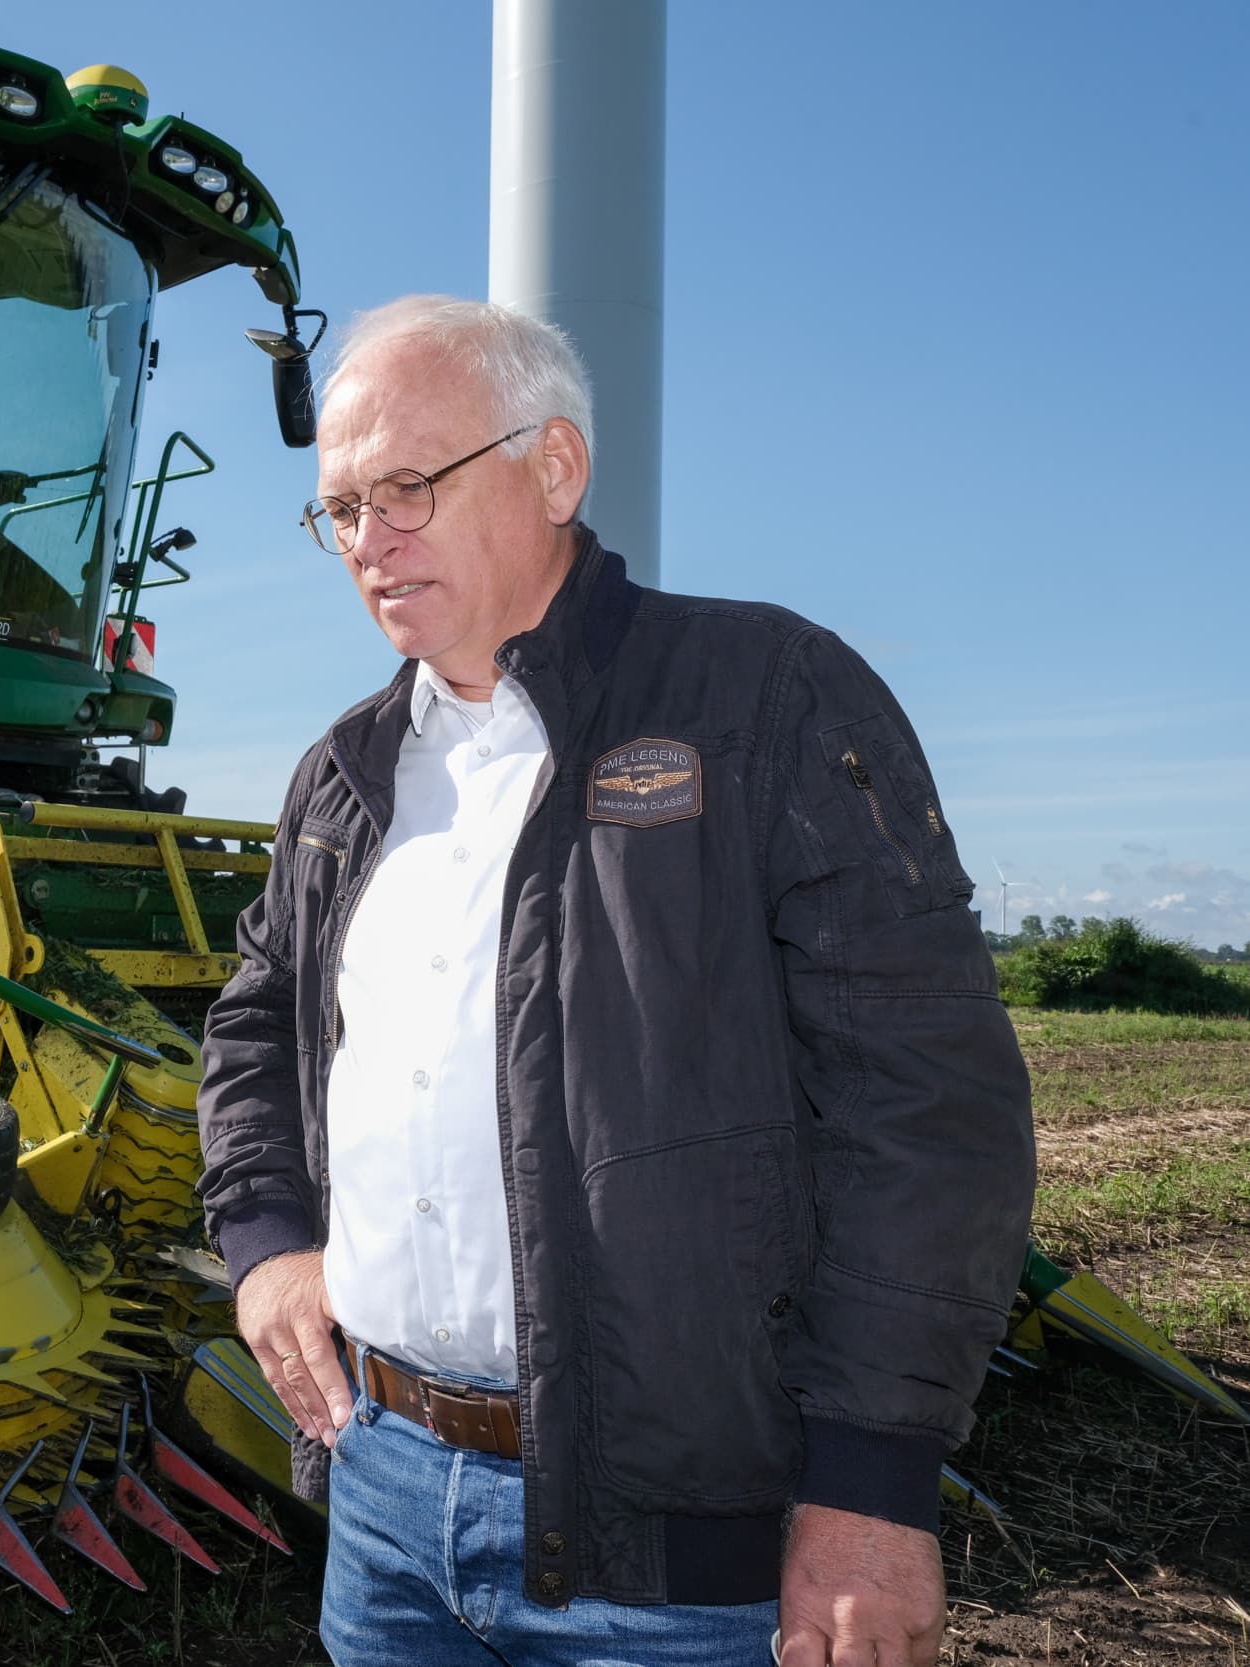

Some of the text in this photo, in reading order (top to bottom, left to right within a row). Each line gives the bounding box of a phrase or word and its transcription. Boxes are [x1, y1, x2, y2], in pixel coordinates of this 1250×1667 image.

[599, 749, 688, 776] PME LEGEND
[597, 794, 692, 810] AMERICAN CLASSIC
